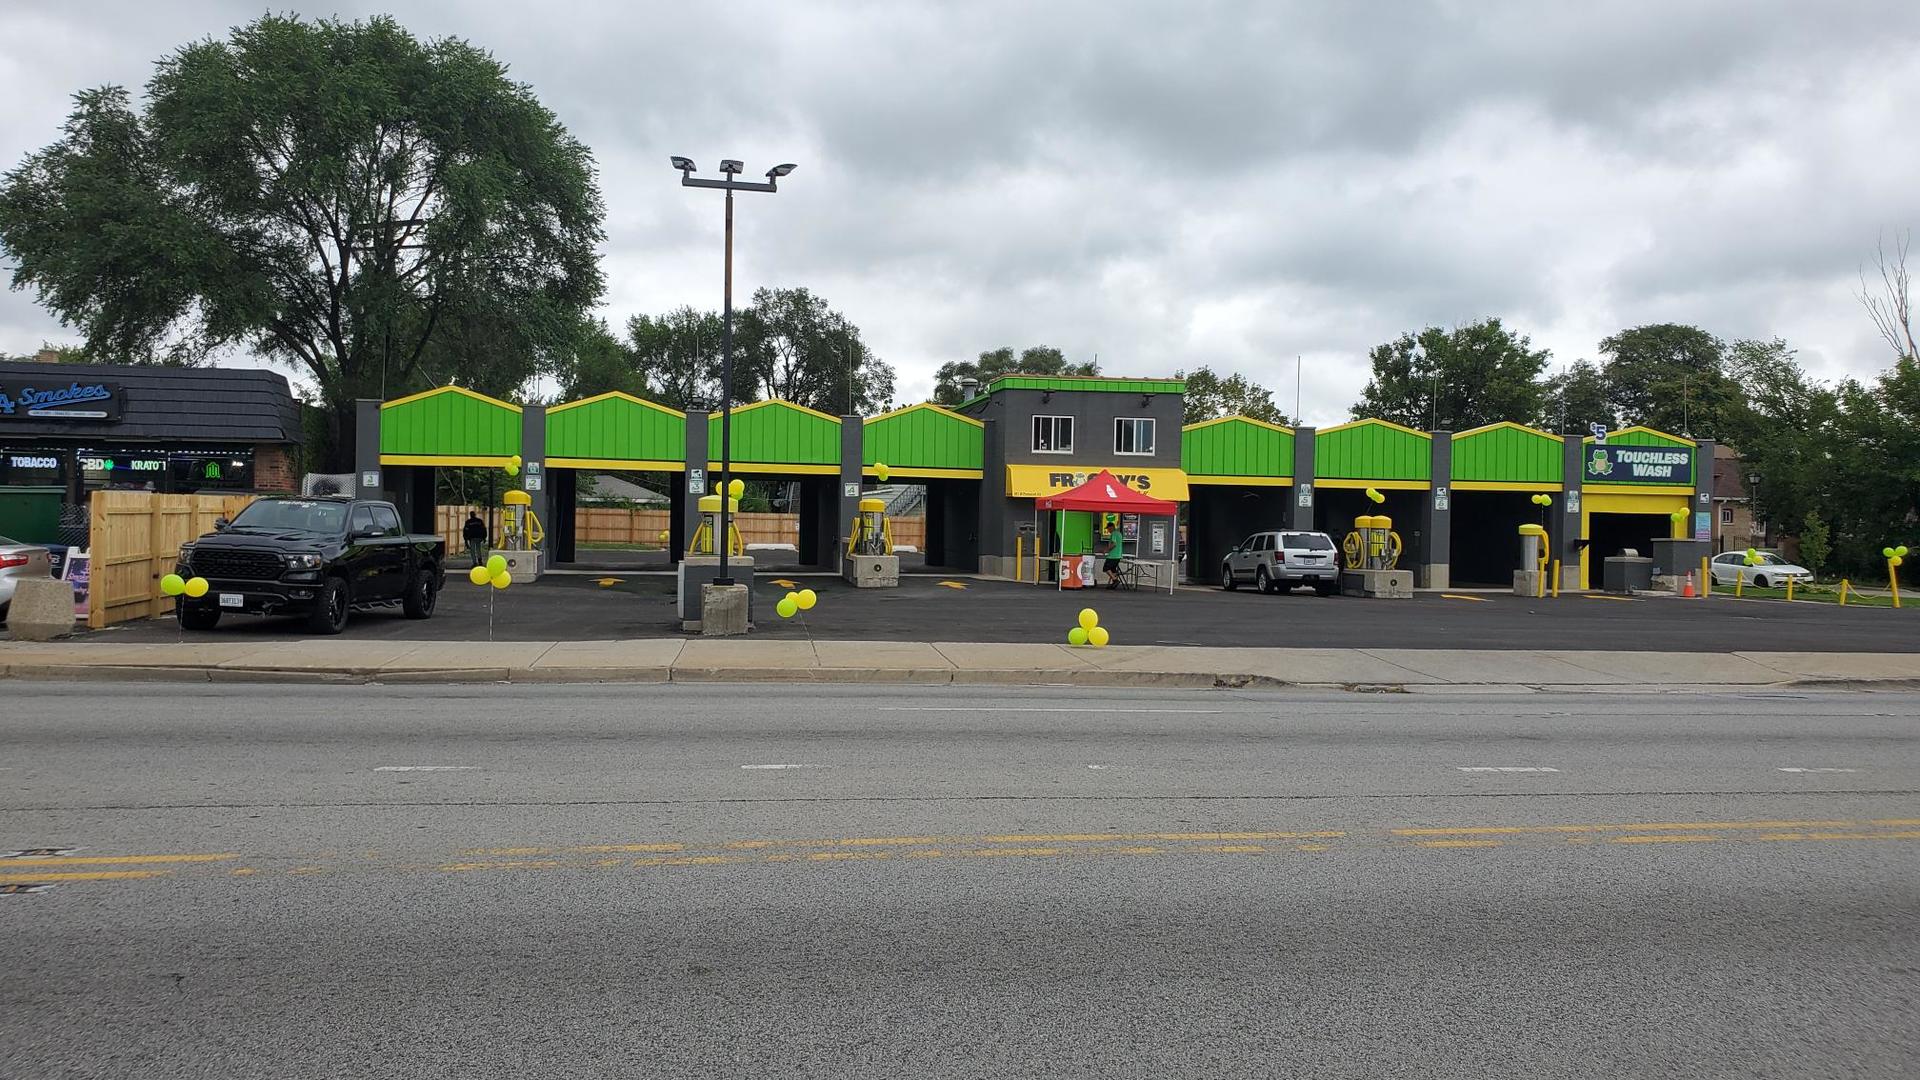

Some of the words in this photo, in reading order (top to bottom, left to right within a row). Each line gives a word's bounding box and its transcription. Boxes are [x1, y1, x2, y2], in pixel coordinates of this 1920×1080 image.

[18, 382, 111, 407] Smokes
[10, 456, 57, 468] TOBACCO
[1616, 450, 1689, 465] TOUCHLESS
[1632, 464, 1672, 477] WASH
[1049, 473, 1151, 490] FRY'S
